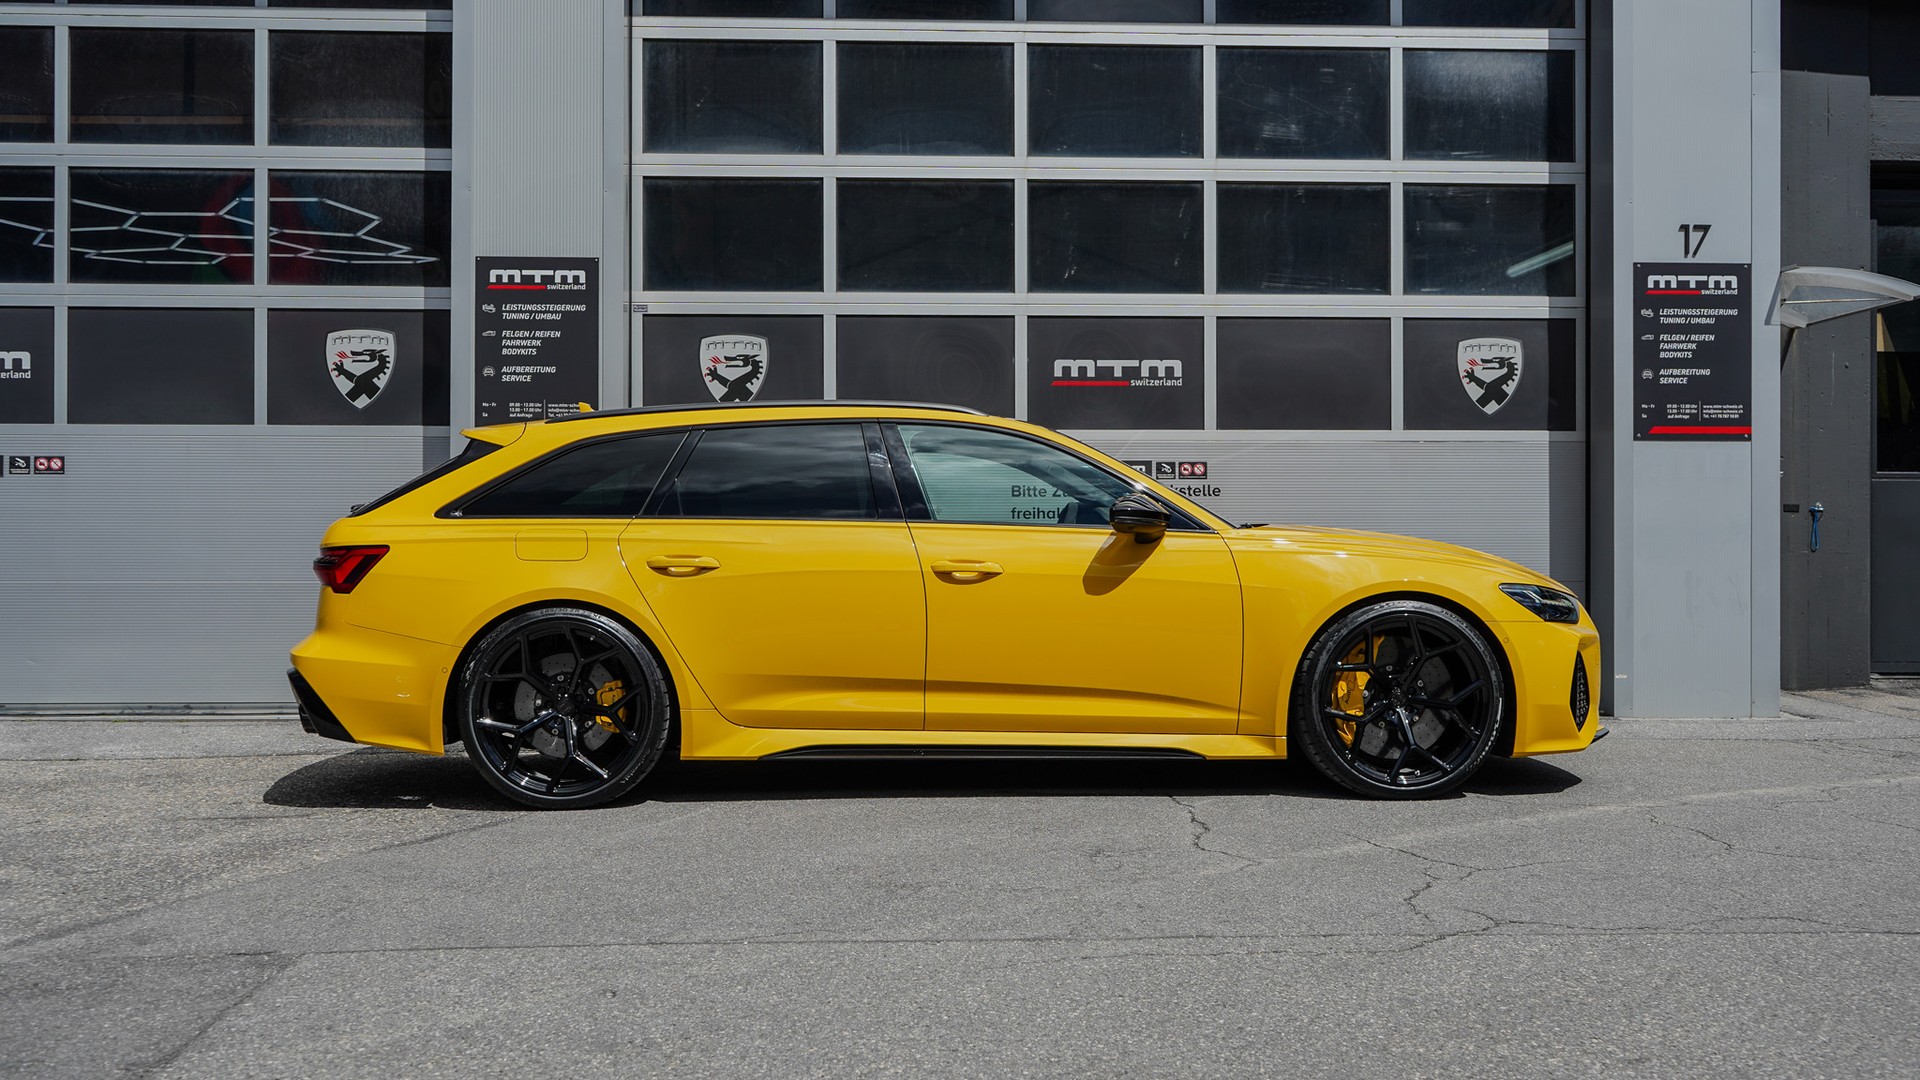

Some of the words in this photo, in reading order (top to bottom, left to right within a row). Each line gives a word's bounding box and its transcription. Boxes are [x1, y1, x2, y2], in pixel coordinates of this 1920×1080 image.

[1678, 224, 1712, 259] 17
[502, 303, 586, 312] LEISTUNGSSTEIGERUNG
[1659, 308, 1738, 316] LEISTUNGSSTEIGERUNG
[1690, 317, 1715, 325] UMBAU
[1659, 334, 1685, 342] FELGEN
[1690, 334, 1715, 342] REIFEN
[502, 339, 542, 347] FAHRWERK
[501, 348, 537, 356] BODYKITS
[1659, 351, 1693, 359] BODYKITS
[501, 366, 556, 374] AUFBEREITUNG
[1659, 368, 1711, 376] AUFBEREITUNG
[0, 370, 31, 379] erland
[1130, 377, 1183, 387] switzerland
[1659, 377, 1688, 385] SERVICE
[1011, 485, 1047, 498] Bitte
[1011, 507, 1061, 520] freihal
